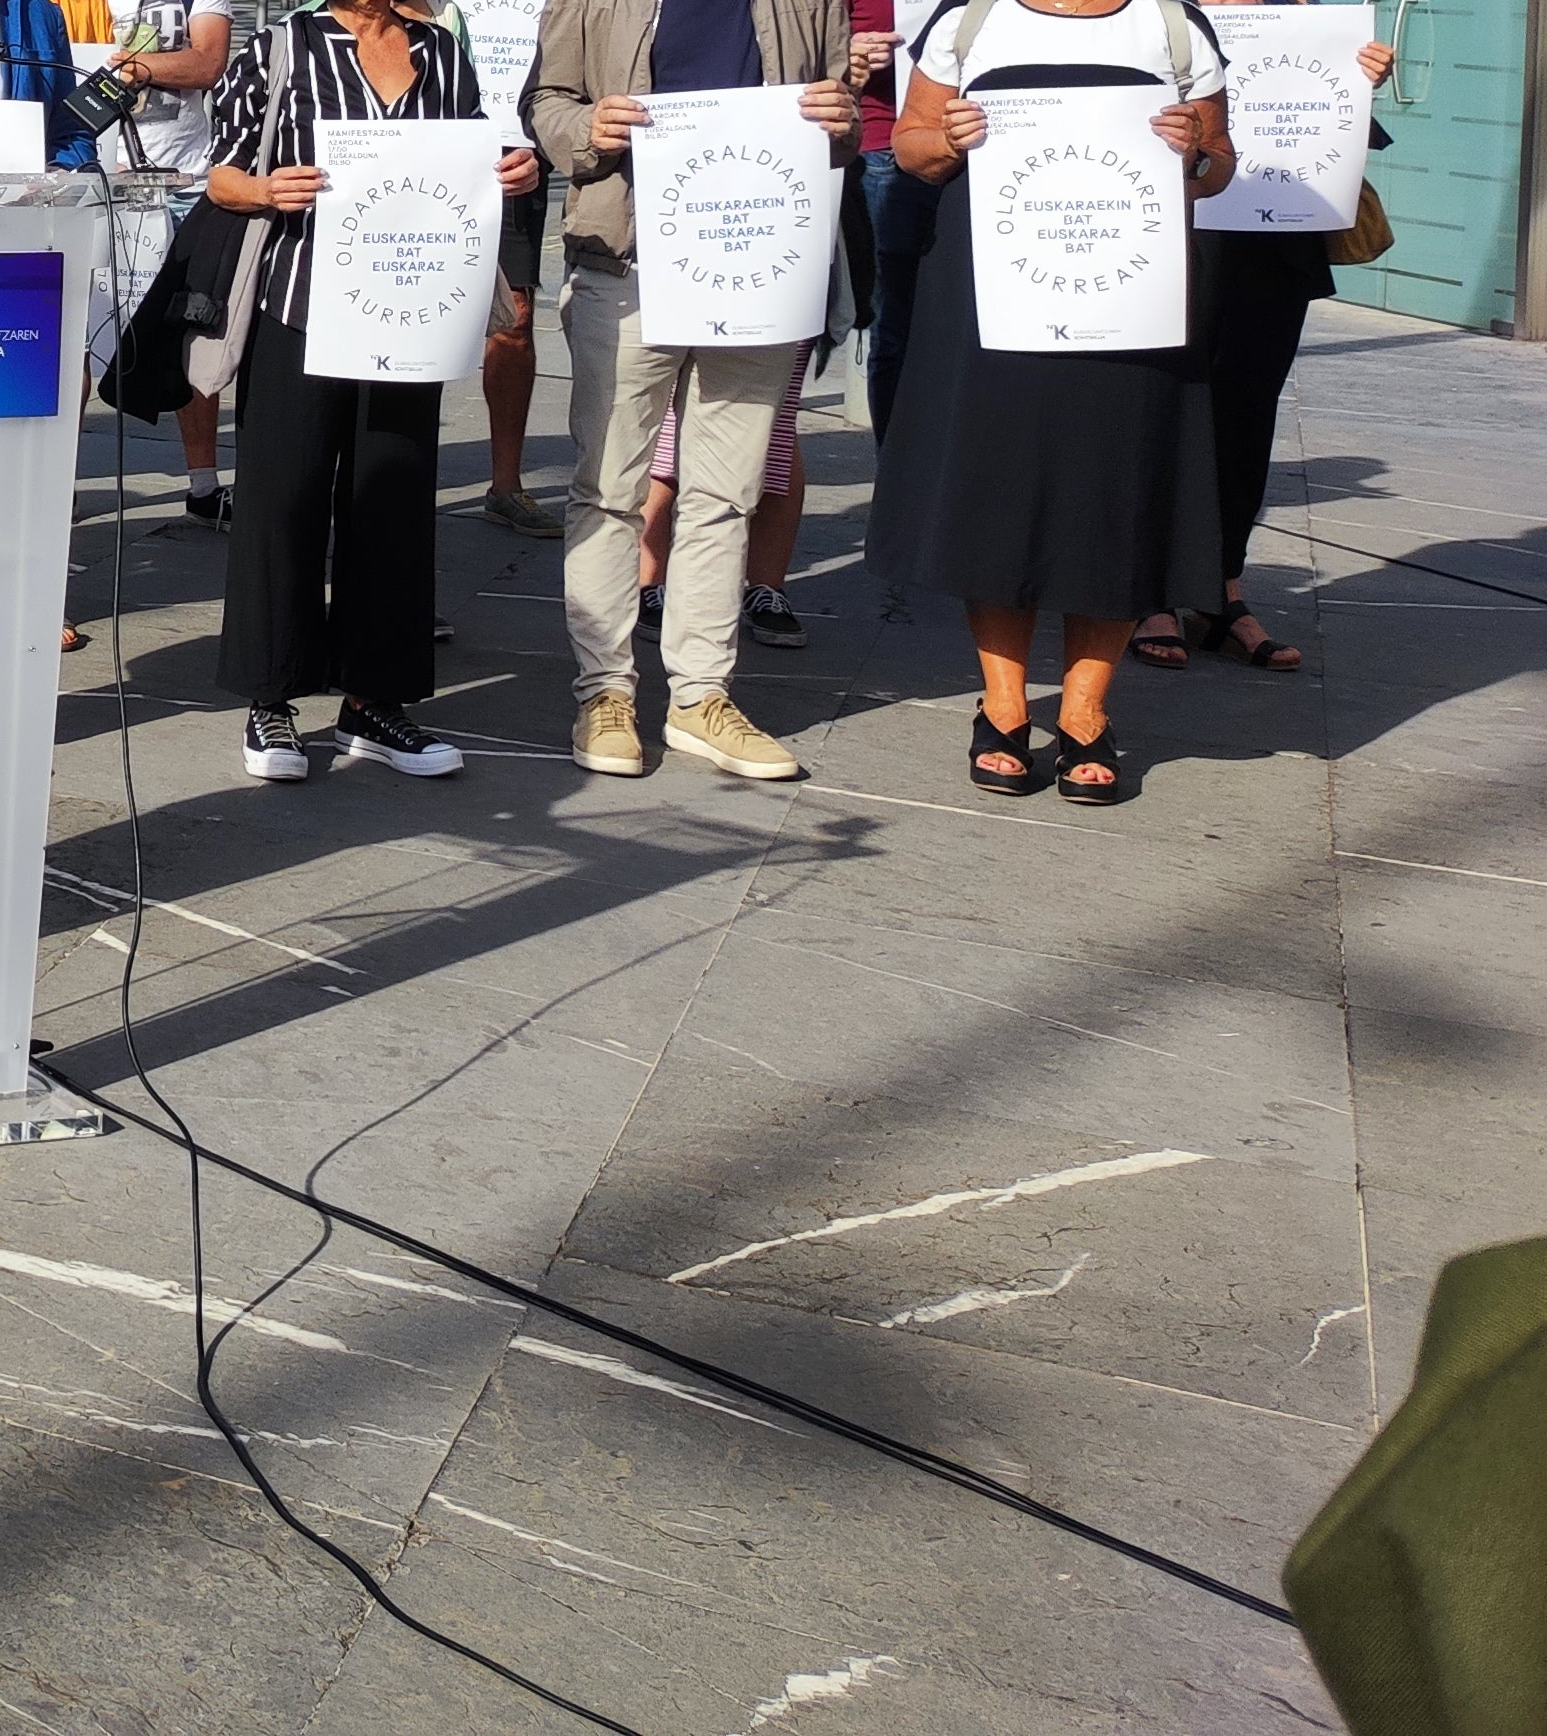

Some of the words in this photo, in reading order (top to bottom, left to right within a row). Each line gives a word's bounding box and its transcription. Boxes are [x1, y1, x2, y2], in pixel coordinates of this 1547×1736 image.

[492, 47, 513, 55] BAT
[490, 67, 511, 76] BAT
[981, 98, 1063, 107] MANIFESTAZIOA
[1244, 102, 1331, 112] EUSKARAEKIN
[1275, 114, 1299, 124] BAT
[1253, 126, 1321, 136] EUSKARAZ
[1275, 138, 1299, 148] BAT
[1234, 148, 1342, 184] AURREAN
[659, 145, 811, 236] OLDARRALDIAREN
[995, 144, 1161, 235] OLDARRALDIAREN
[686, 197, 785, 213] EUSKARAEKIN
[1024, 200, 1132, 212] EUSKARAEKIN
[336, 176, 481, 267] OLDARRALDIAREN
[722, 213, 750, 225] BAT
[1063, 215, 1093, 225] BAT
[698, 225, 775, 240] EUSKARAZ
[1037, 229, 1121, 240] EUSKARAZ
[362, 233, 457, 244] EUSKARAEKIN
[724, 241, 751, 252] BAT
[1065, 243, 1095, 254] BAT
[396, 247, 423, 258] BAT
[372, 261, 445, 272] EUSKARAZ
[672, 248, 801, 291] AURREAN
[1010, 253, 1150, 294] AURREAN
[395, 275, 422, 286] BAT
[344, 286, 467, 327] AURREAN
